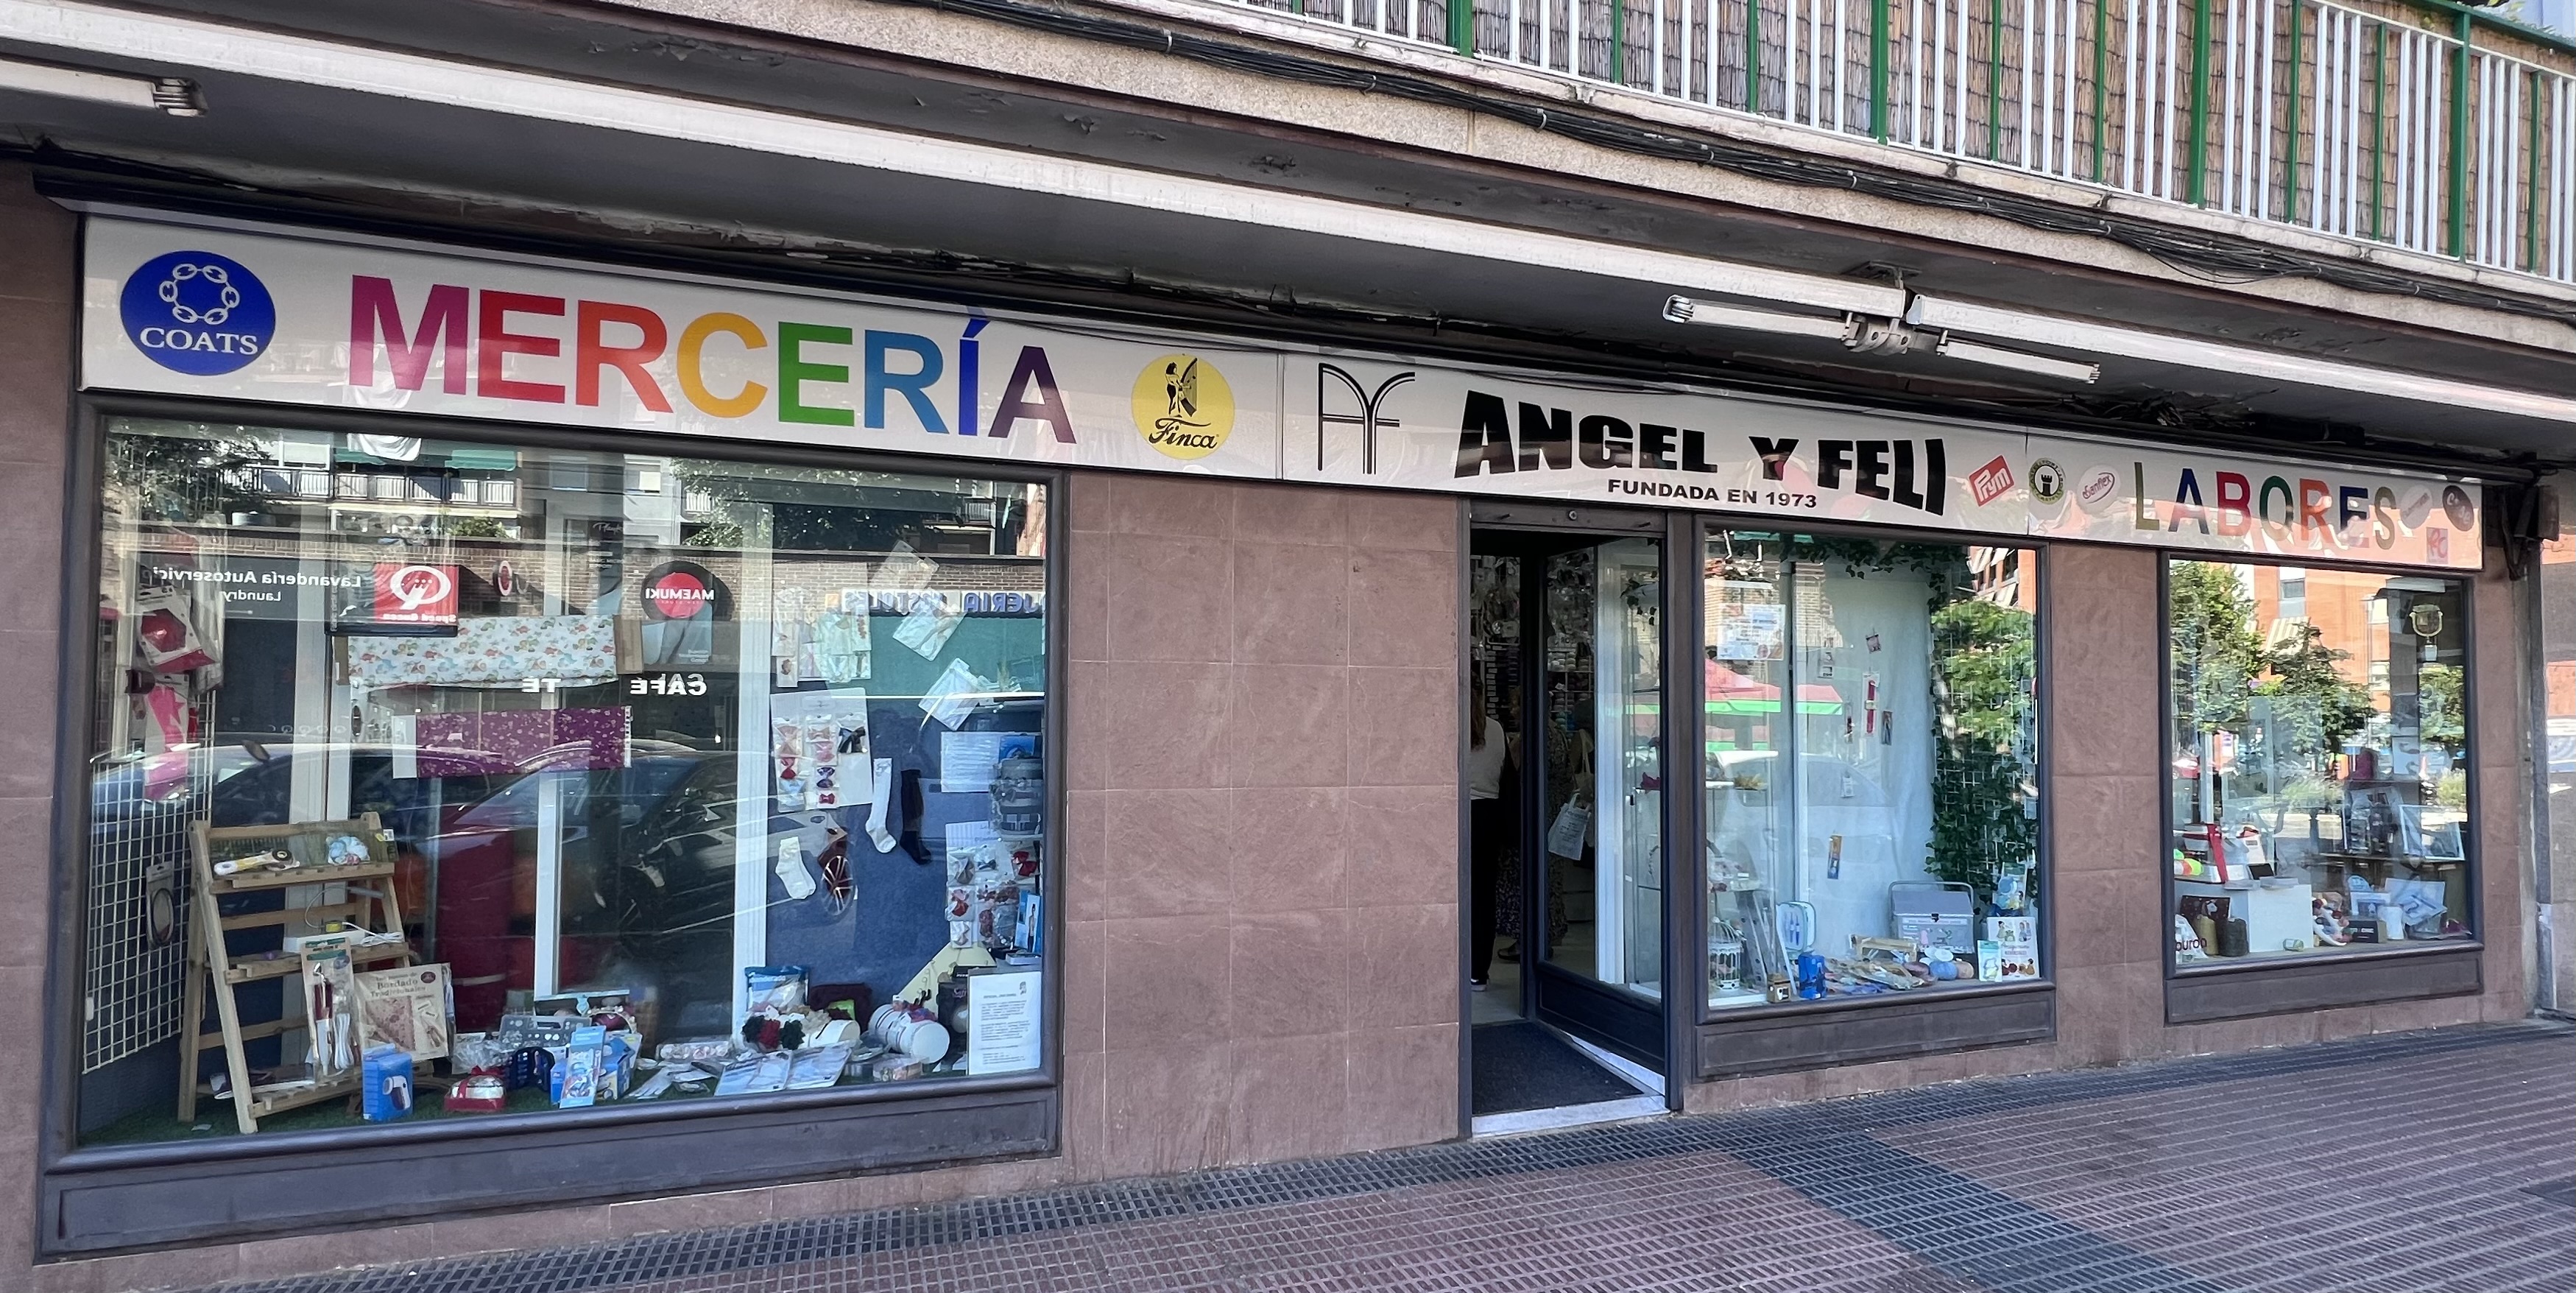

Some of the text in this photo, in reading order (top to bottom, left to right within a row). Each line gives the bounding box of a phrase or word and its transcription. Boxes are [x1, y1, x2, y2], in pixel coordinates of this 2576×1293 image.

[140, 326, 259, 356] COATS
[348, 275, 1077, 445] MERCERÍA
[1148, 418, 1219, 450] Finca
[1454, 390, 1947, 517] ANGEL Y FELI
[1608, 479, 1818, 509] FUNDADA EN 1973
[1974, 468, 2011, 502] Prym
[2134, 461, 2396, 551] LABORES
[377, 978, 418, 990] Bordado
